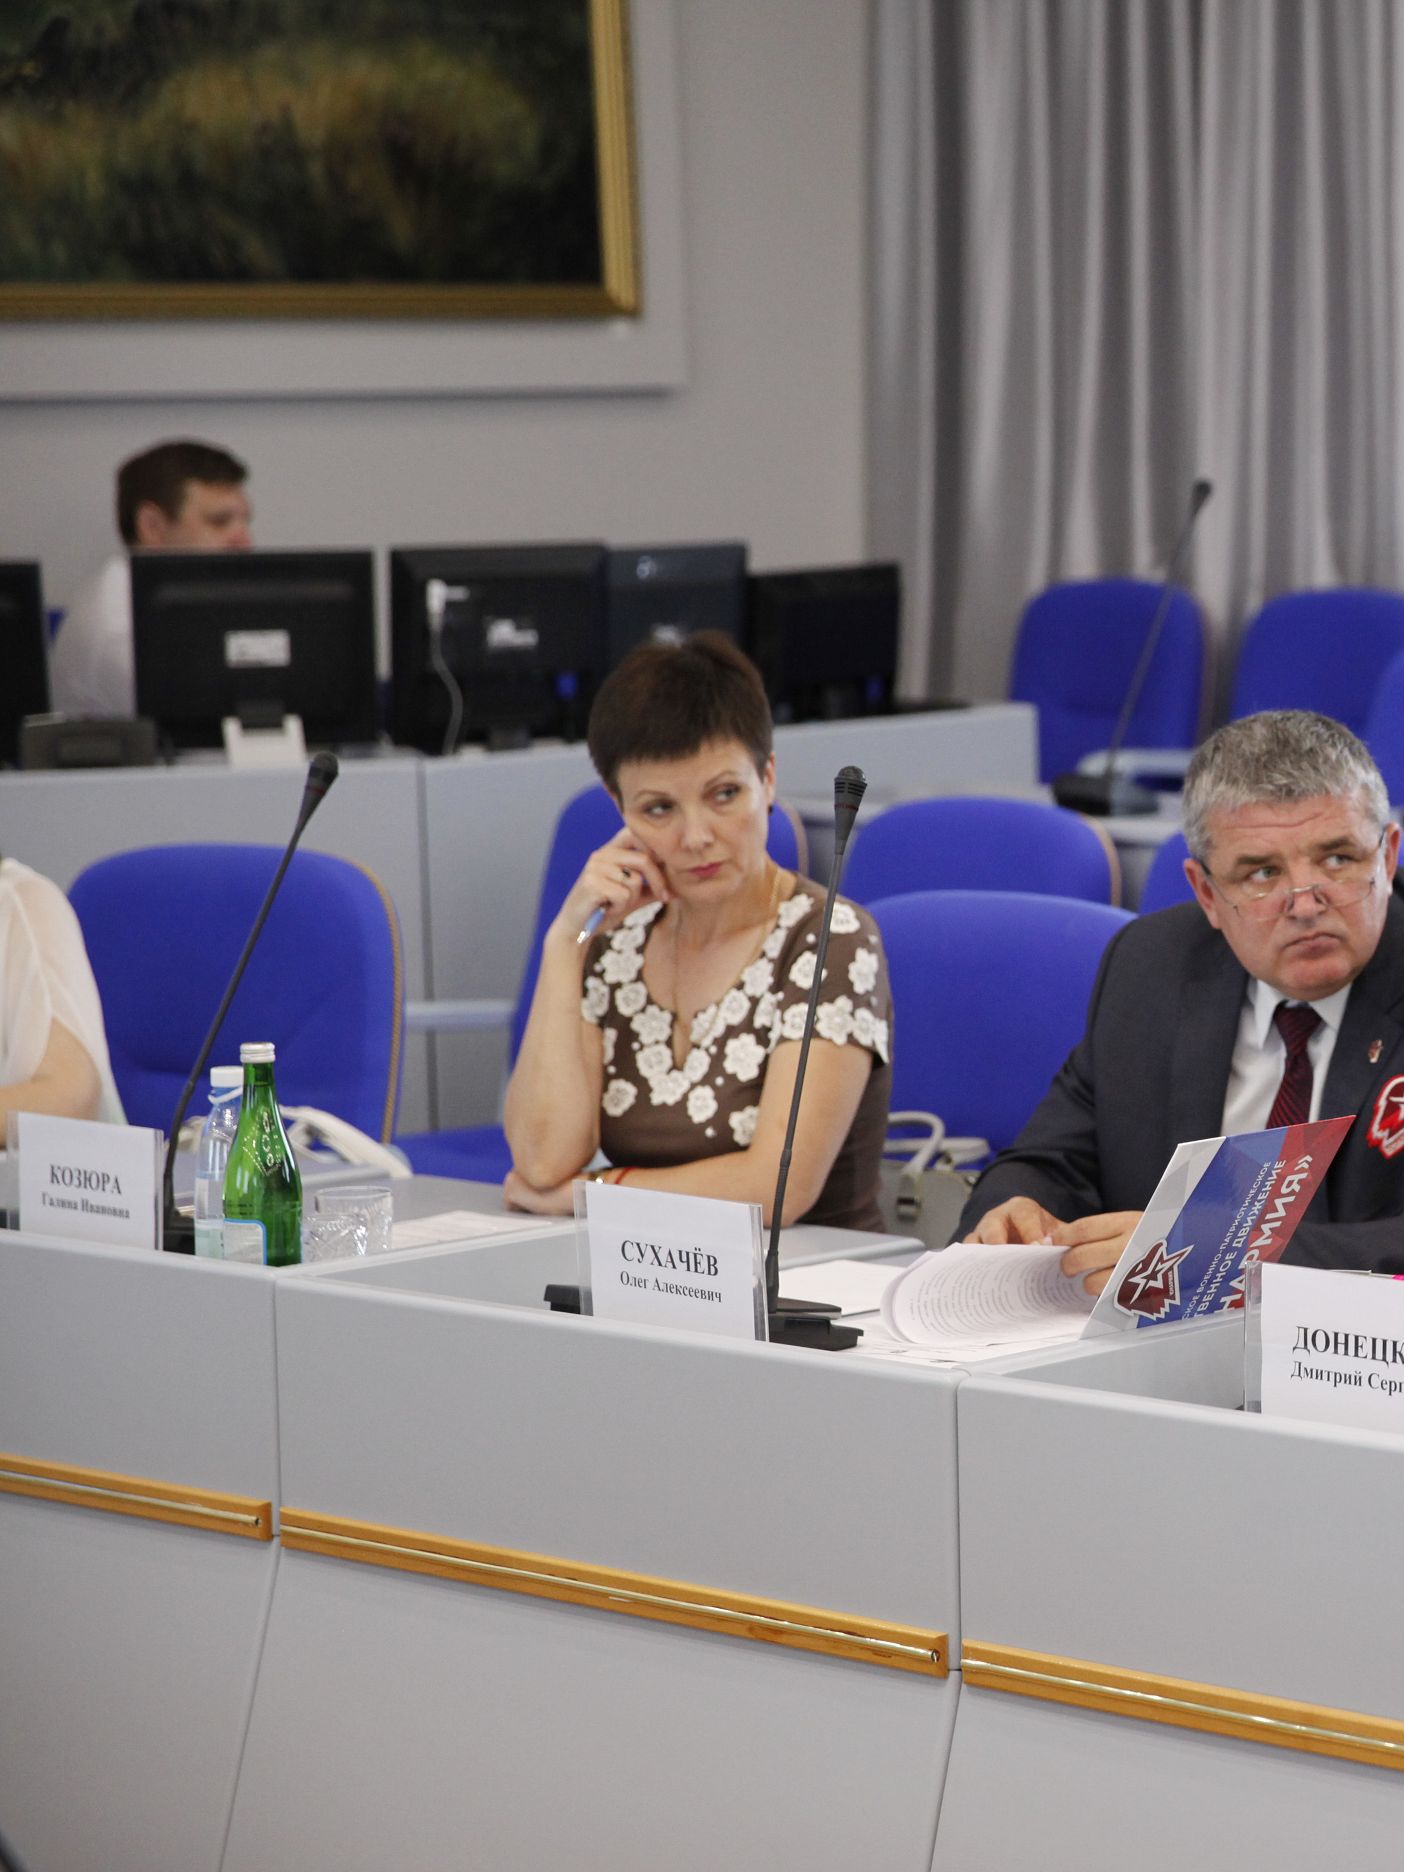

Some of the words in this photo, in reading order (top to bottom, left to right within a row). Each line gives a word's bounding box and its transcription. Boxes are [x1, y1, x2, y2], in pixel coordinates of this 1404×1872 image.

[49, 1164, 122, 1195] КОЗЮРА
[1232, 1159, 1286, 1248] ДВИЖЕНИЕ
[1196, 1161, 1271, 1293] ВОЕННО-ПАТРИОТИЧЕСКОЕ
[620, 1239, 719, 1277] СУХАЧЁВ
[620, 1271, 650, 1289] Олег
[652, 1277, 722, 1303] Алексеевич
[1290, 1360, 1363, 1388] Дмитрий
